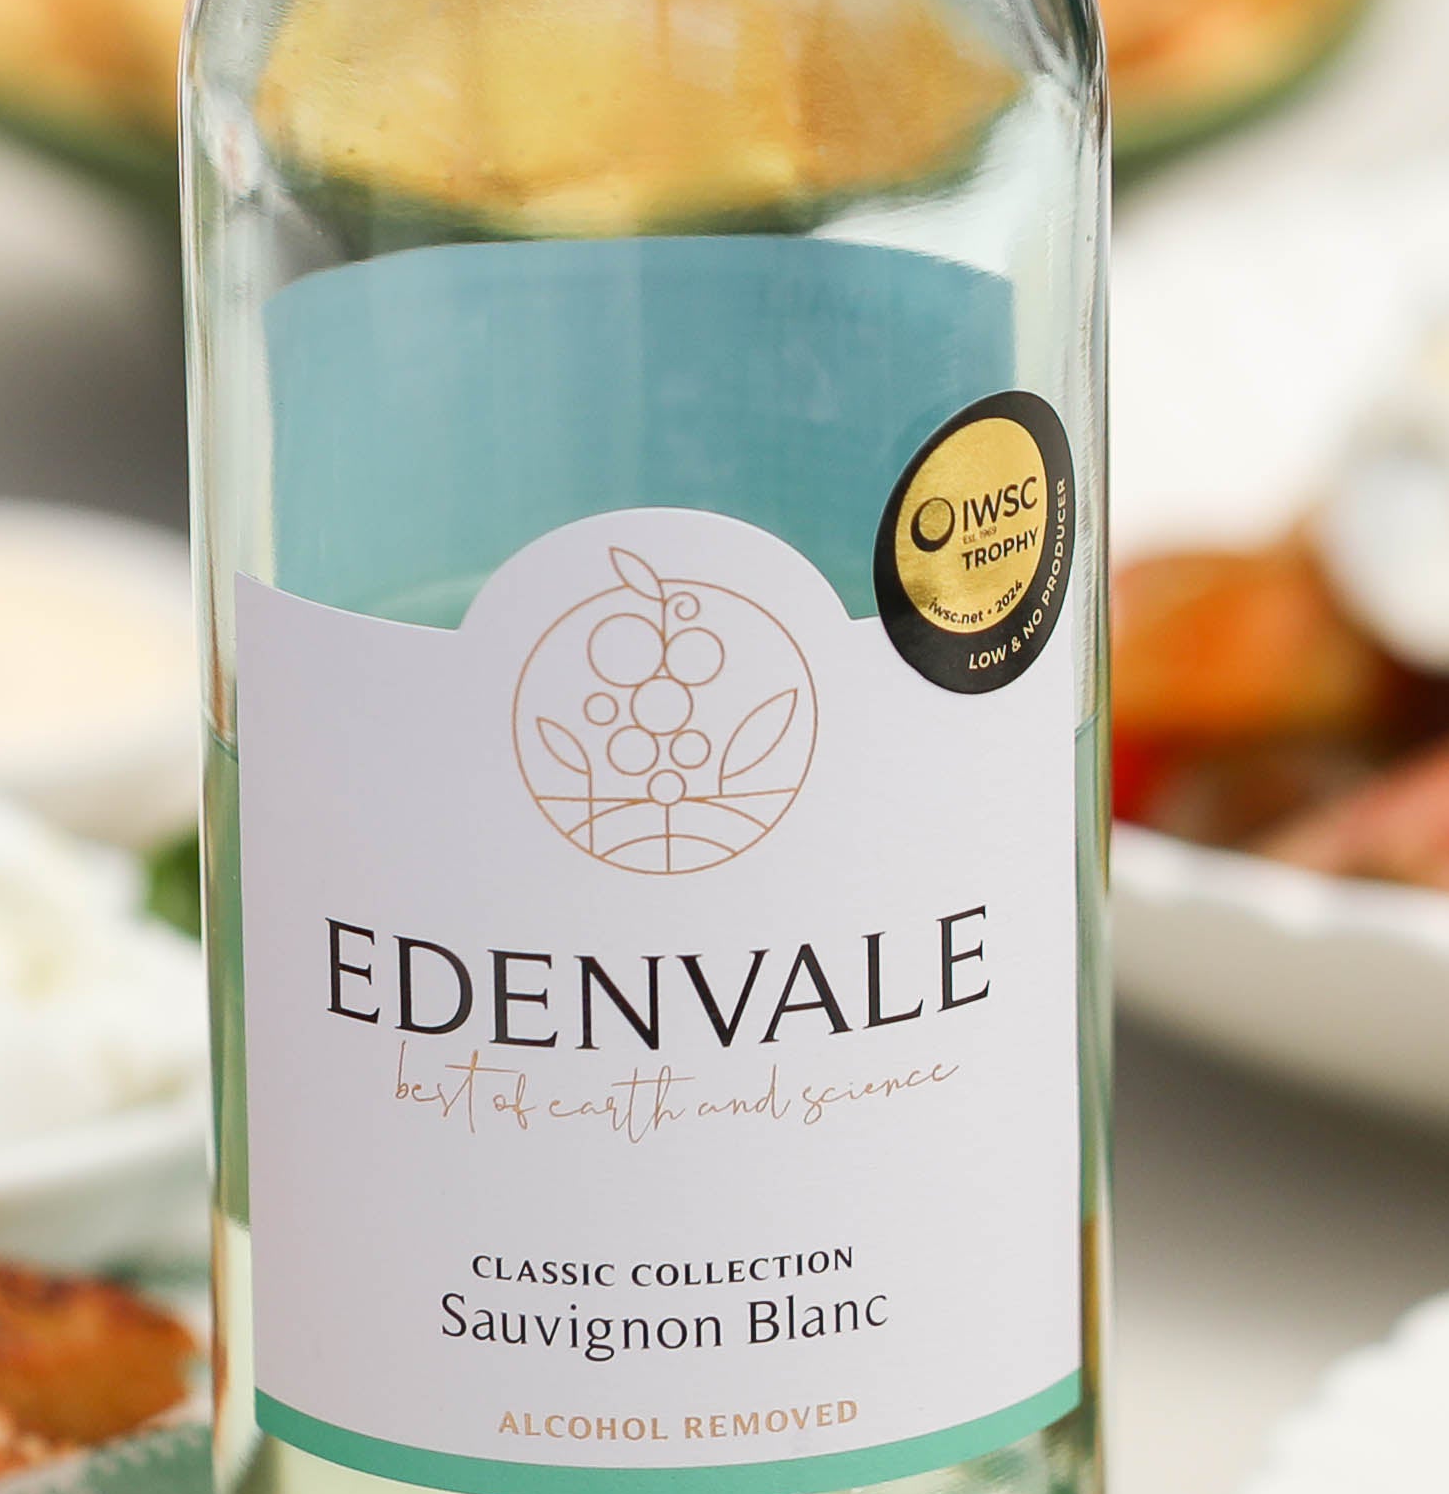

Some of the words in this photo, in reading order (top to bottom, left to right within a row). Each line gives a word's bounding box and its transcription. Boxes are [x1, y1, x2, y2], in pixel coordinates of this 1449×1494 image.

[962, 476, 1038, 532] IWSC
[961, 527, 1039, 571] TROPHY
[968, 643, 1008, 670] LOW
[1011, 636, 1022, 653] &
[1023, 610, 1044, 640] NO
[1041, 477, 1067, 608] PRODUCER
[928, 597, 984, 624] iwsc.net
[995, 579, 1023, 614] 2024
[324, 904, 990, 1050] EDENVALE
[395, 1040, 518, 1133] best
[493, 1073, 540, 1129] of
[549, 1066, 695, 1144] earth
[698, 1064, 791, 1124] and
[802, 1063, 959, 1125] science
[472, 1255, 616, 1287] CLASSIC
[631, 1246, 854, 1287] COLLECTION
[441, 1292, 722, 1362] Sauvignon
[747, 1293, 889, 1345] Blanc
[498, 1410, 668, 1441] ALCOHOL
[684, 1399, 859, 1439] REMOVED
